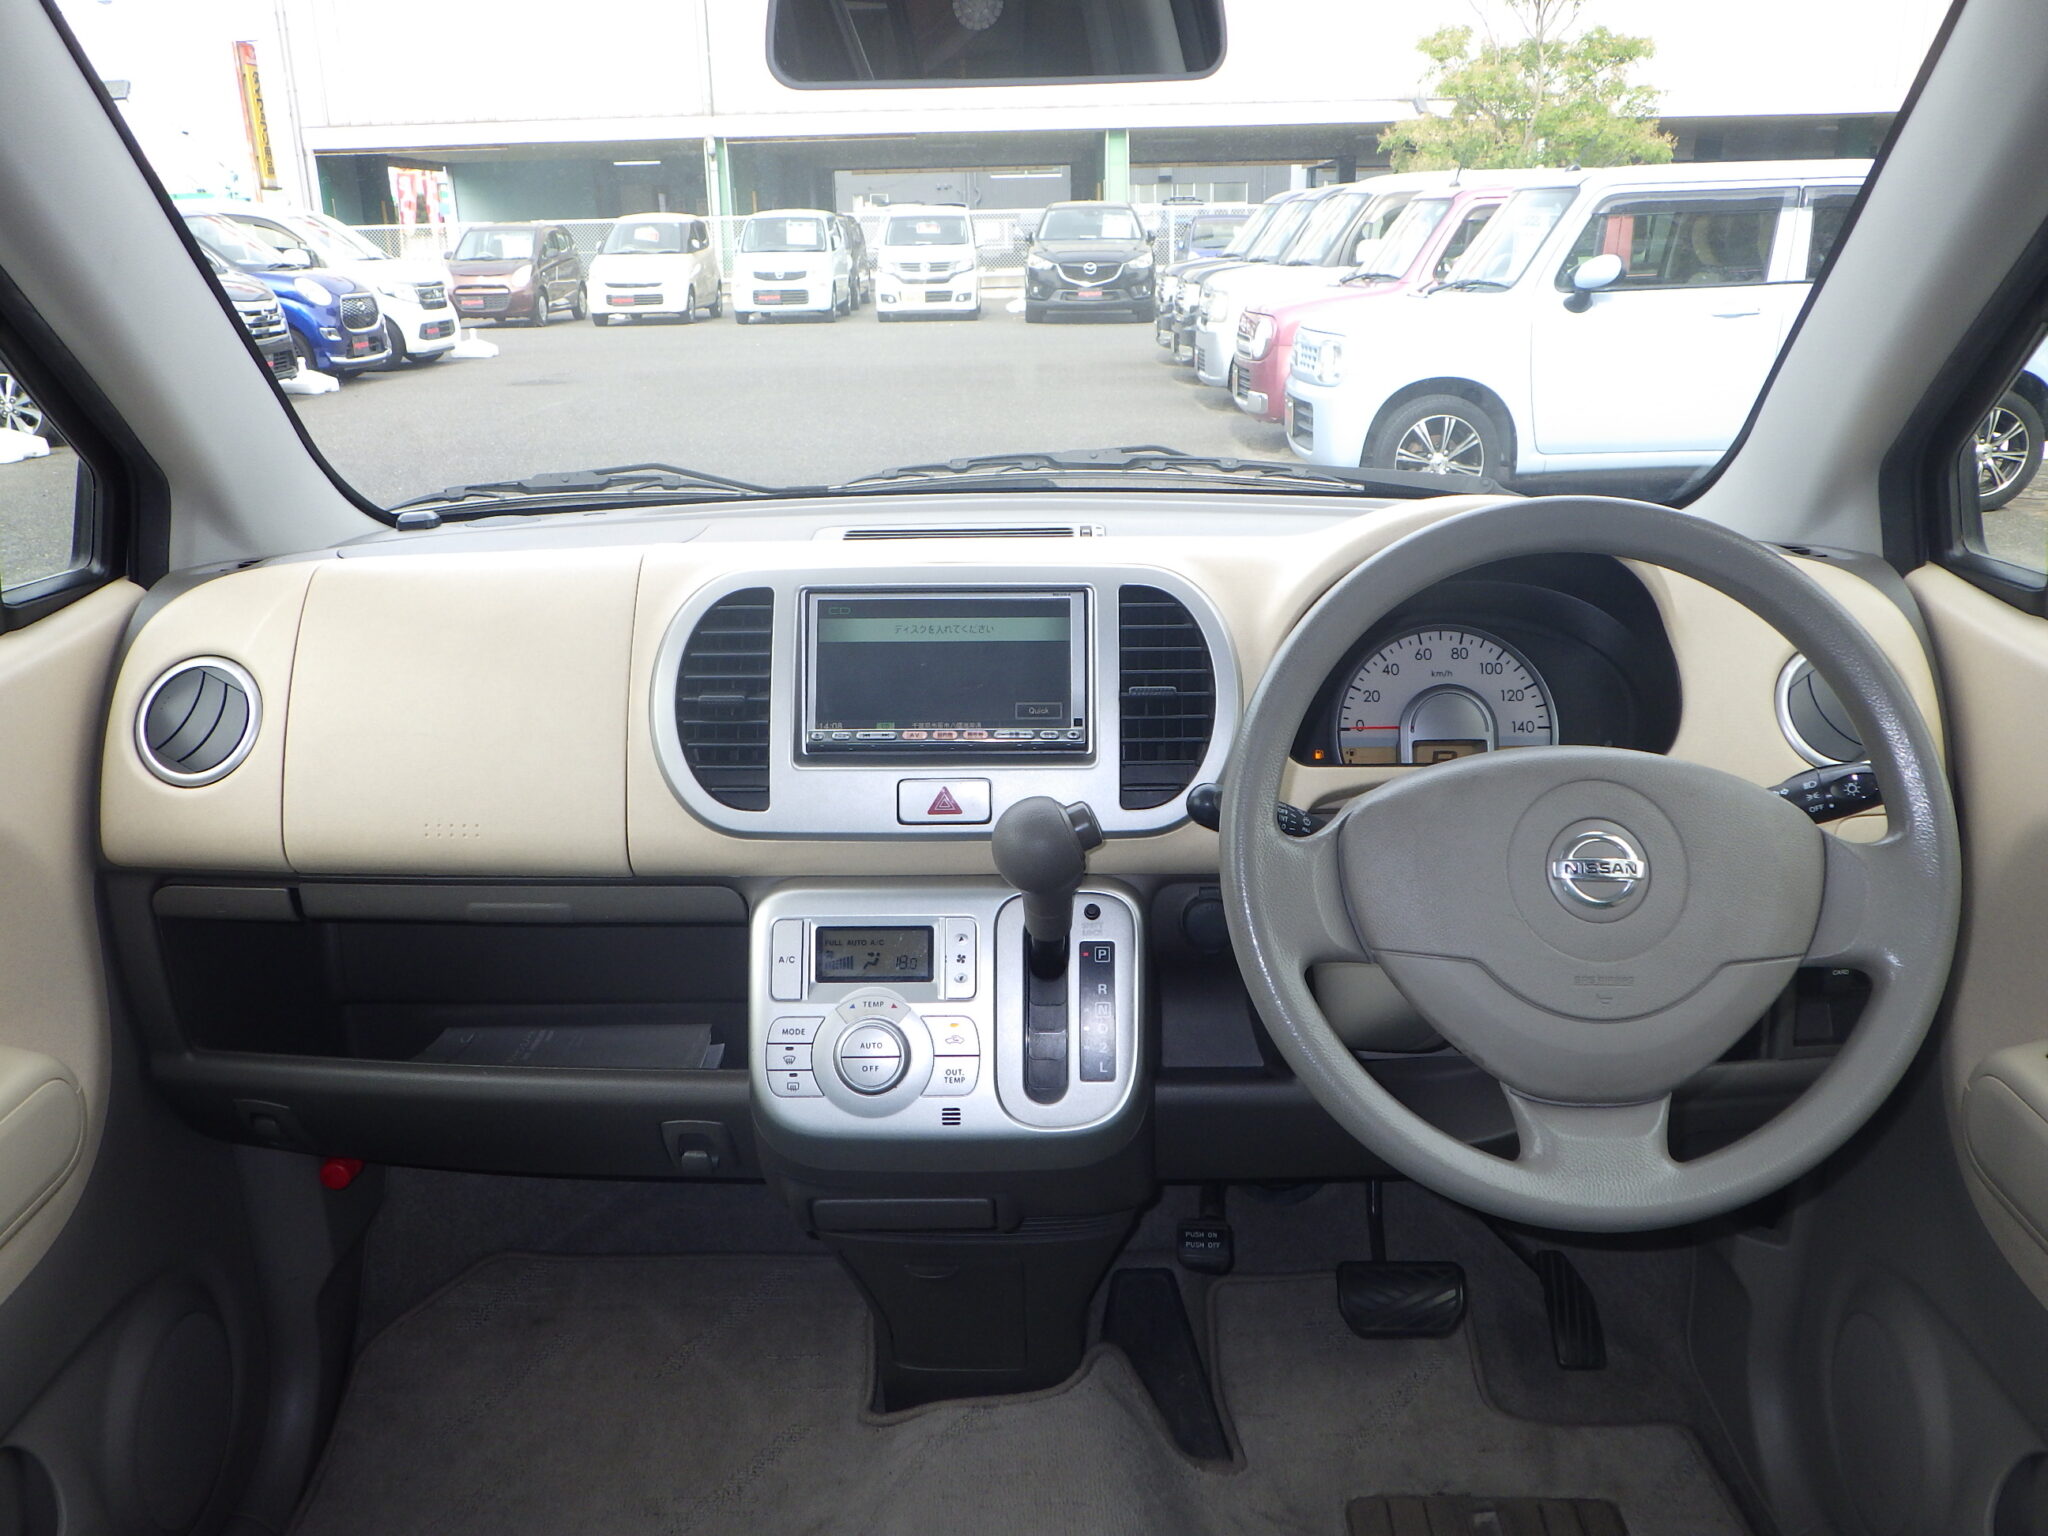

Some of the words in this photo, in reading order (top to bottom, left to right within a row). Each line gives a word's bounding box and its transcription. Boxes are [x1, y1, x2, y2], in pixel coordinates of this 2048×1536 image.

[894, 624, 995, 634] ディスクを入れてください
[1414, 647, 1433, 661] 60
[1450, 647, 1469, 660] 80
[1382, 663, 1400, 676] 40
[1430, 669, 1453, 678] km/h
[1479, 662, 1503, 675] 100
[1363, 690, 1381, 703] 20
[1501, 688, 1525, 702] 120
[1028, 706, 1049, 714] Quick
[1355, 719, 1365, 732] 0
[1511, 720, 1535, 733] 140
[1809, 803, 1825, 813] OFF
[1564, 862, 1638, 875] NISSAN
[778, 955, 796, 964] A/C
[1098, 949, 1107, 960] P
[1098, 984, 1107, 995] R
[863, 1000, 885, 1008] TEMP
[1098, 1005, 1108, 1015] N
[782, 1028, 806, 1036] MODE
[1098, 1024, 1108, 1034] D
[860, 1041, 883, 1050] AUTO
[1099, 1042, 1108, 1053] 2
[861, 1064, 879, 1073] OFF
[1099, 1062, 1108, 1073] L
[945, 1069, 965, 1077] OUT.
[944, 1076, 966, 1084] TEMP
